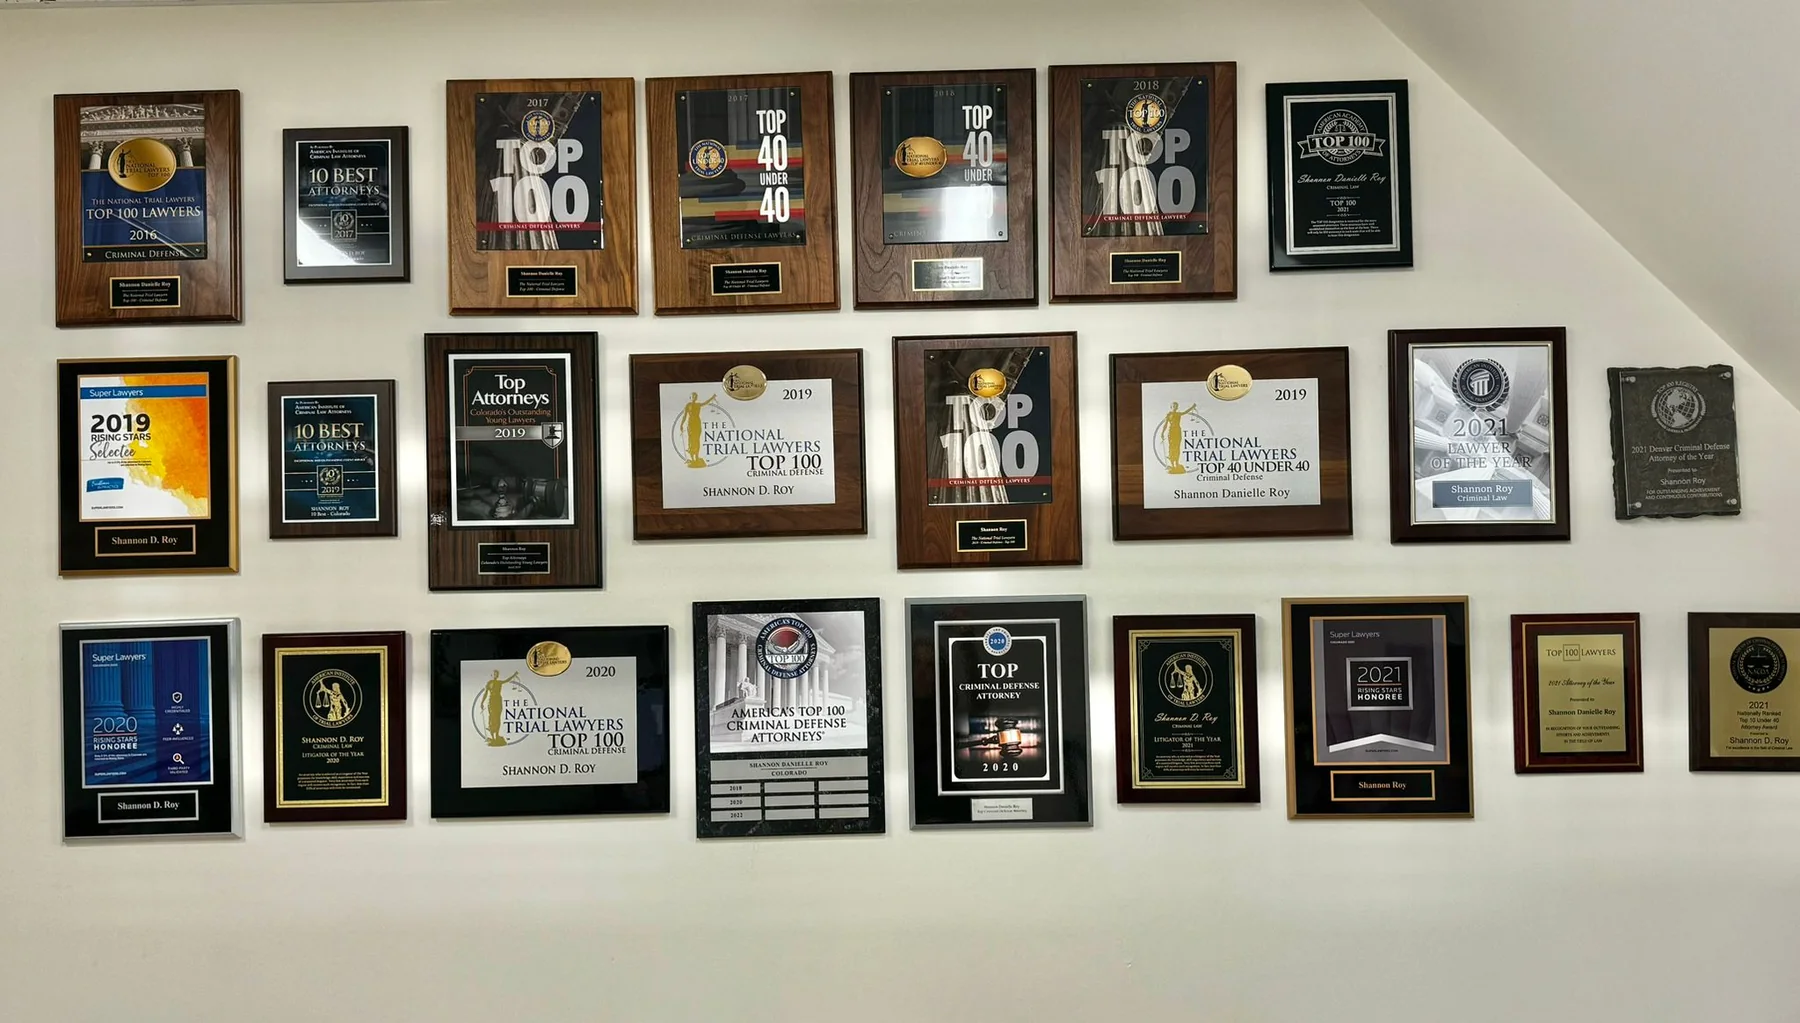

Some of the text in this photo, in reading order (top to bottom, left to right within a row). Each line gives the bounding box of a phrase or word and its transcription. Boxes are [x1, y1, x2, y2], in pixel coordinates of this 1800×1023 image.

[1133, 81, 1159, 90] 2018
[527, 99, 549, 107] 2017
[756, 110, 786, 134] TOP
[962, 105, 993, 129] TOP
[1102, 129, 1191, 165] TOP
[1312, 136, 1370, 148] TOP 100
[758, 135, 788, 171] 40
[963, 131, 993, 167] 40
[496, 139, 583, 174] TOP
[309, 167, 378, 183] 10 BEST
[760, 173, 788, 185] UNDER
[965, 169, 992, 181] UNDER
[308, 185, 379, 196] ATTORNEYS
[1095, 166, 1196, 213] 100
[490, 175, 589, 223] 100
[760, 187, 790, 223] 40
[86, 206, 200, 220] TOP 100 LAWYERS
[130, 230, 157, 240] 2016
[105, 251, 146, 259] CRIMINAL
[495, 375, 526, 393] Top
[90, 389, 143, 398] Super Lawyers
[783, 389, 812, 400] 2019
[1275, 389, 1307, 400] 2019
[472, 391, 549, 409] Attorneys
[946, 394, 1033, 430] TOP
[91, 414, 150, 432] 2019
[485, 417, 507, 425] Young
[295, 423, 364, 439] 10 BEST
[495, 428, 525, 438] 2019
[1454, 418, 1508, 437] 2021
[123, 433, 151, 441] STARS
[704, 429, 784, 441] NATIONAL
[294, 441, 365, 452] ATTORNEYS
[703, 441, 821, 455] TRIAL LAWYERS
[1184, 437, 1261, 449] NATIONAL
[1448, 442, 1511, 454] LAWYER
[940, 430, 1039, 478] 100
[1183, 448, 1297, 462] TRIAL LAWYERS
[746, 454, 821, 470] TOP 100
[1432, 457, 1532, 468] OF THE YEAR
[703, 485, 794, 497] SHANNON D. ROY
[1174, 488, 1290, 499] Shannon Danielle Roy
[1496, 485, 1513, 494] Roy
[112, 536, 178, 545] Shannon D. Roy
[586, 667, 615, 677] 2020
[978, 663, 1019, 678] TOP
[1358, 666, 1401, 682] 2021
[505, 707, 586, 719] NATIONAL
[732, 706, 845, 718] AMERICA'S TOP 100
[93, 717, 137, 733] 2020
[504, 719, 623, 733] TRIAL LAWYERS
[727, 718, 846, 731] CRIMINAL DEFENSE
[548, 732, 624, 749] TOP 100
[503, 764, 596, 775] SHANNON D. ROY
[983, 763, 1019, 772] 2020
[118, 802, 151, 810] Shannon
[164, 801, 179, 810] Roy
